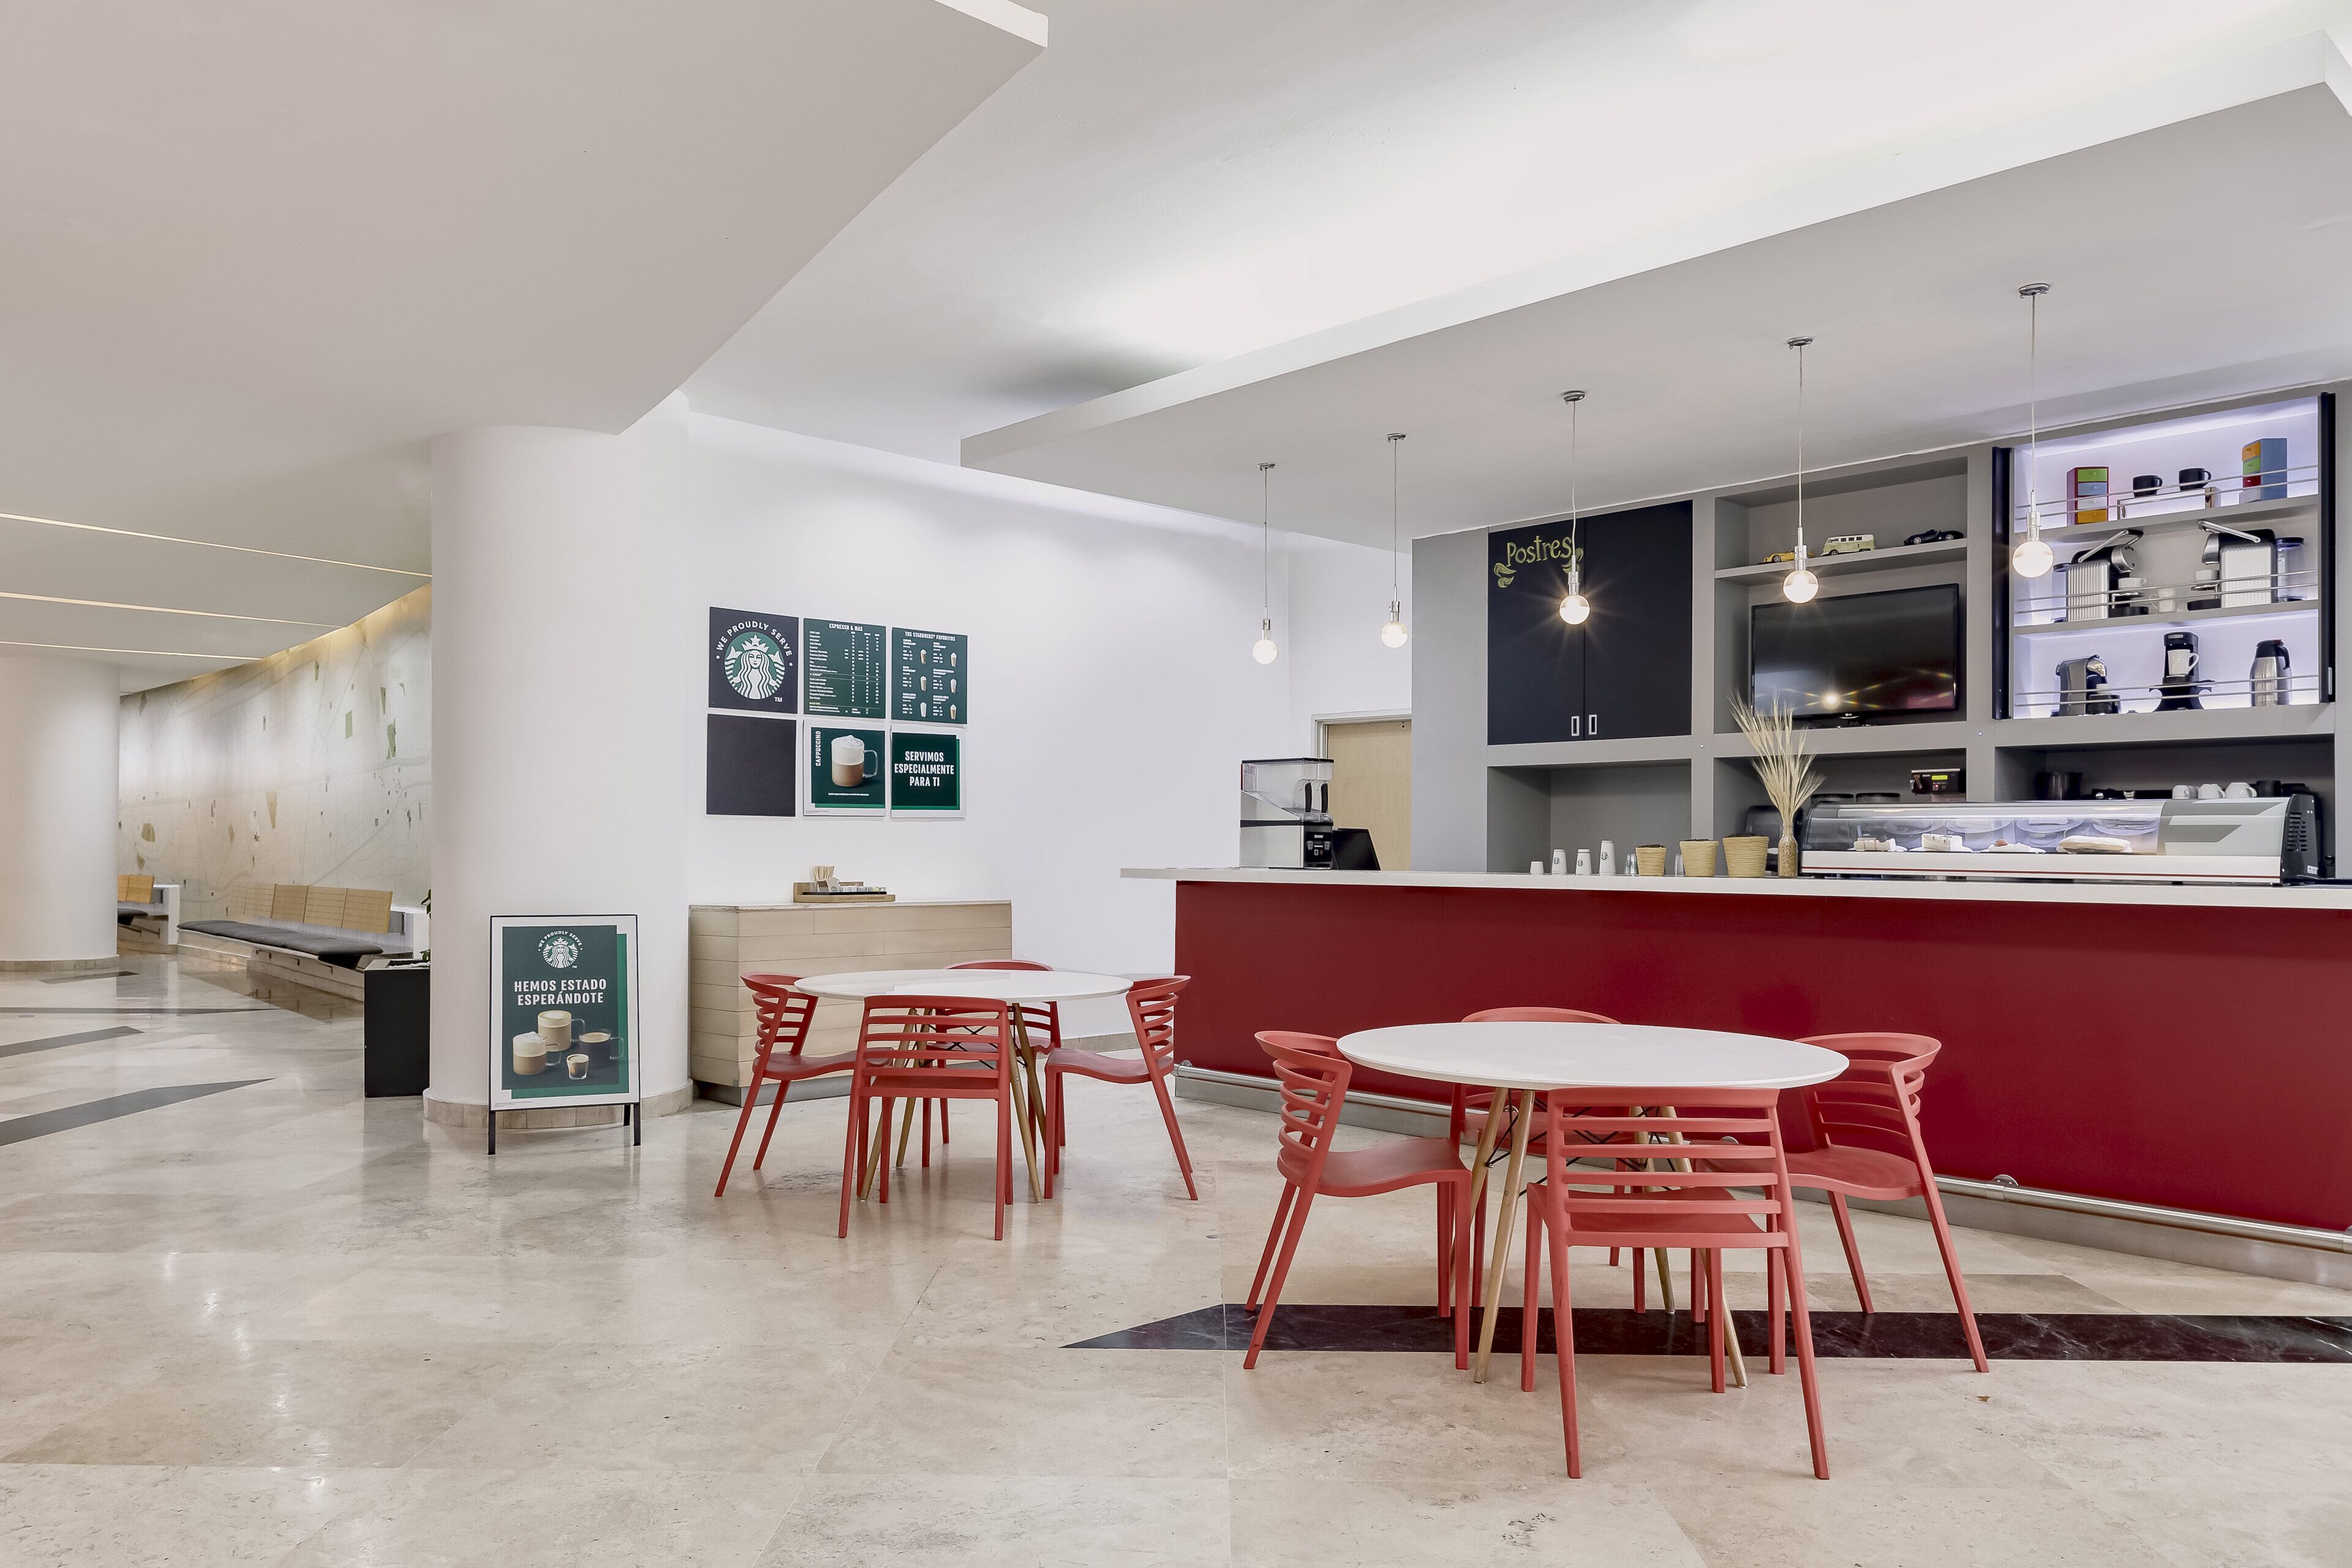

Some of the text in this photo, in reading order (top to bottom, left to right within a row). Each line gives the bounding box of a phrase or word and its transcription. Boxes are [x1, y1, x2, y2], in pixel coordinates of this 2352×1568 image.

[1506, 535, 1573, 567] Postres
[716, 620, 793, 657] WE PROUDLY SERVE
[905, 751, 944, 762] SERVIMOS
[894, 763, 954, 775] ESPECIALMENTE
[910, 776, 940, 787] PARA TI
[538, 930, 582, 948] WE PROUDLY SERVE
[514, 978, 607, 992] HEMOS ESTADO
[518, 991, 604, 1006] ESPERÁNDOTE
